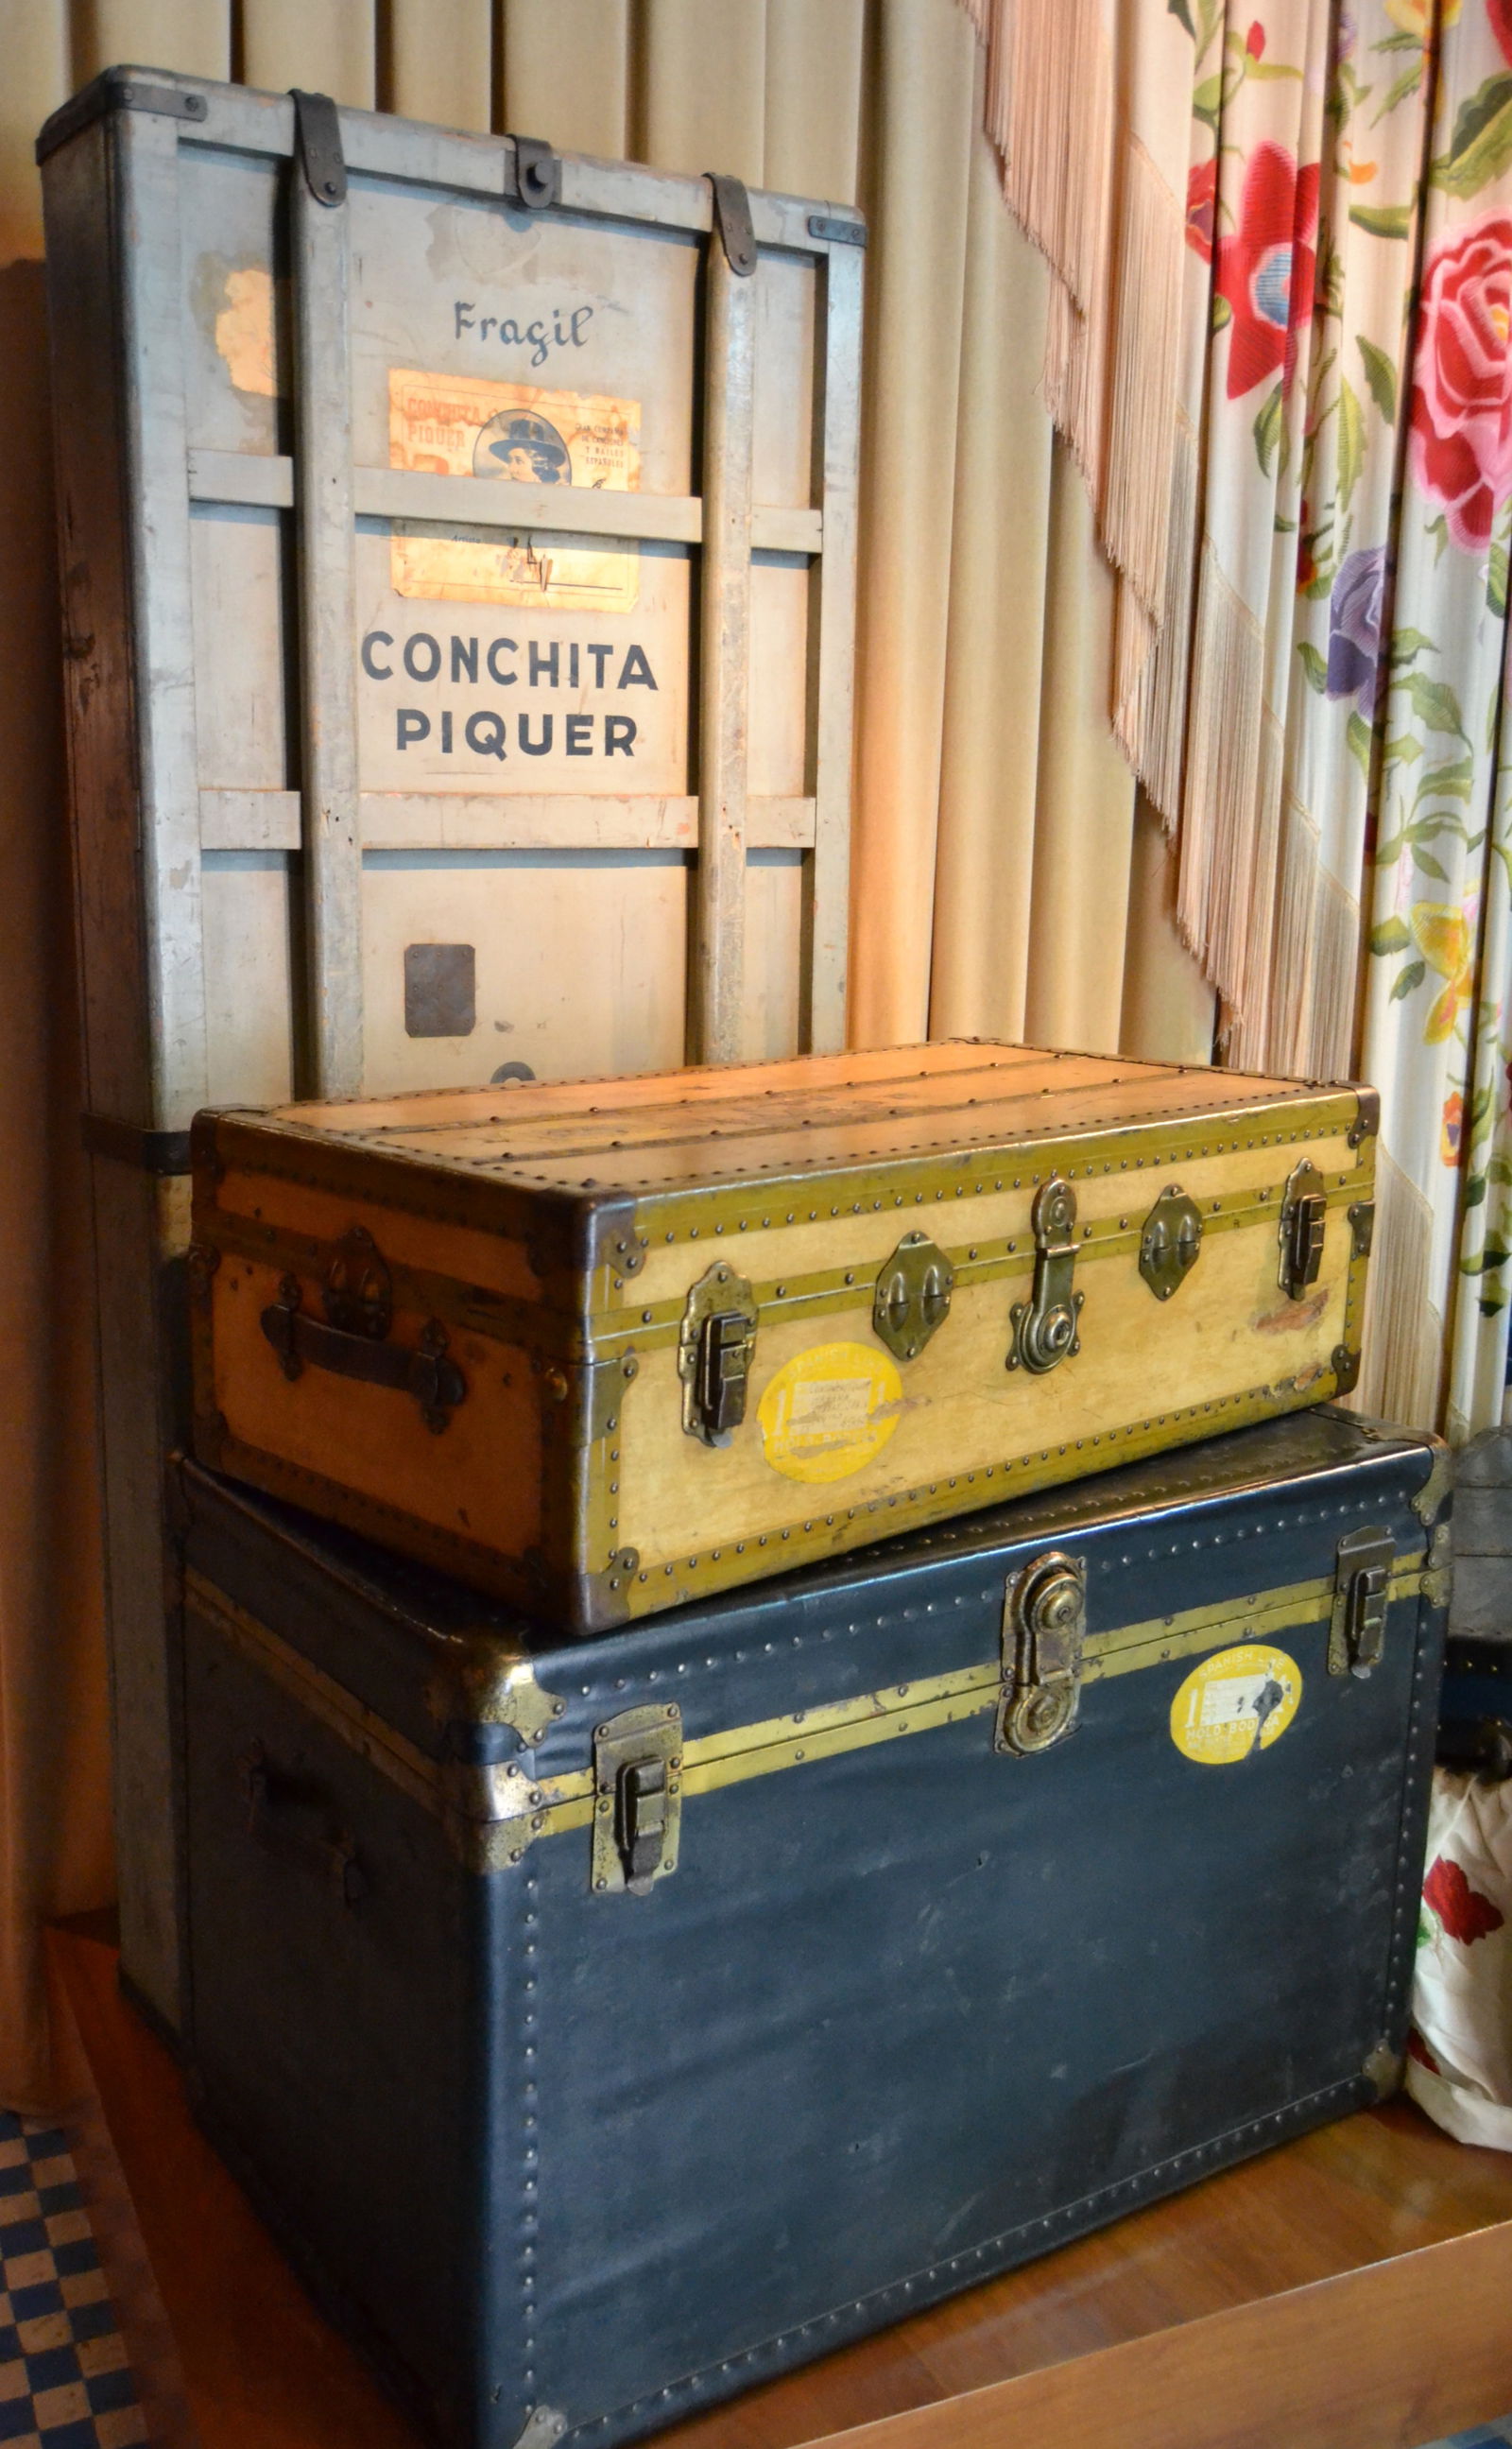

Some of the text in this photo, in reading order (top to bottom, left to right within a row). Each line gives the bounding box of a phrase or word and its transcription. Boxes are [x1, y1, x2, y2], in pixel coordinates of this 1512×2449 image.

[455, 300, 594, 368] Fragil
[407, 422, 465, 447] PIQUER
[361, 630, 659, 691] CONCHITA
[396, 708, 637, 762] PIQUER
[1199, 1650, 1253, 1680] SPANISH
